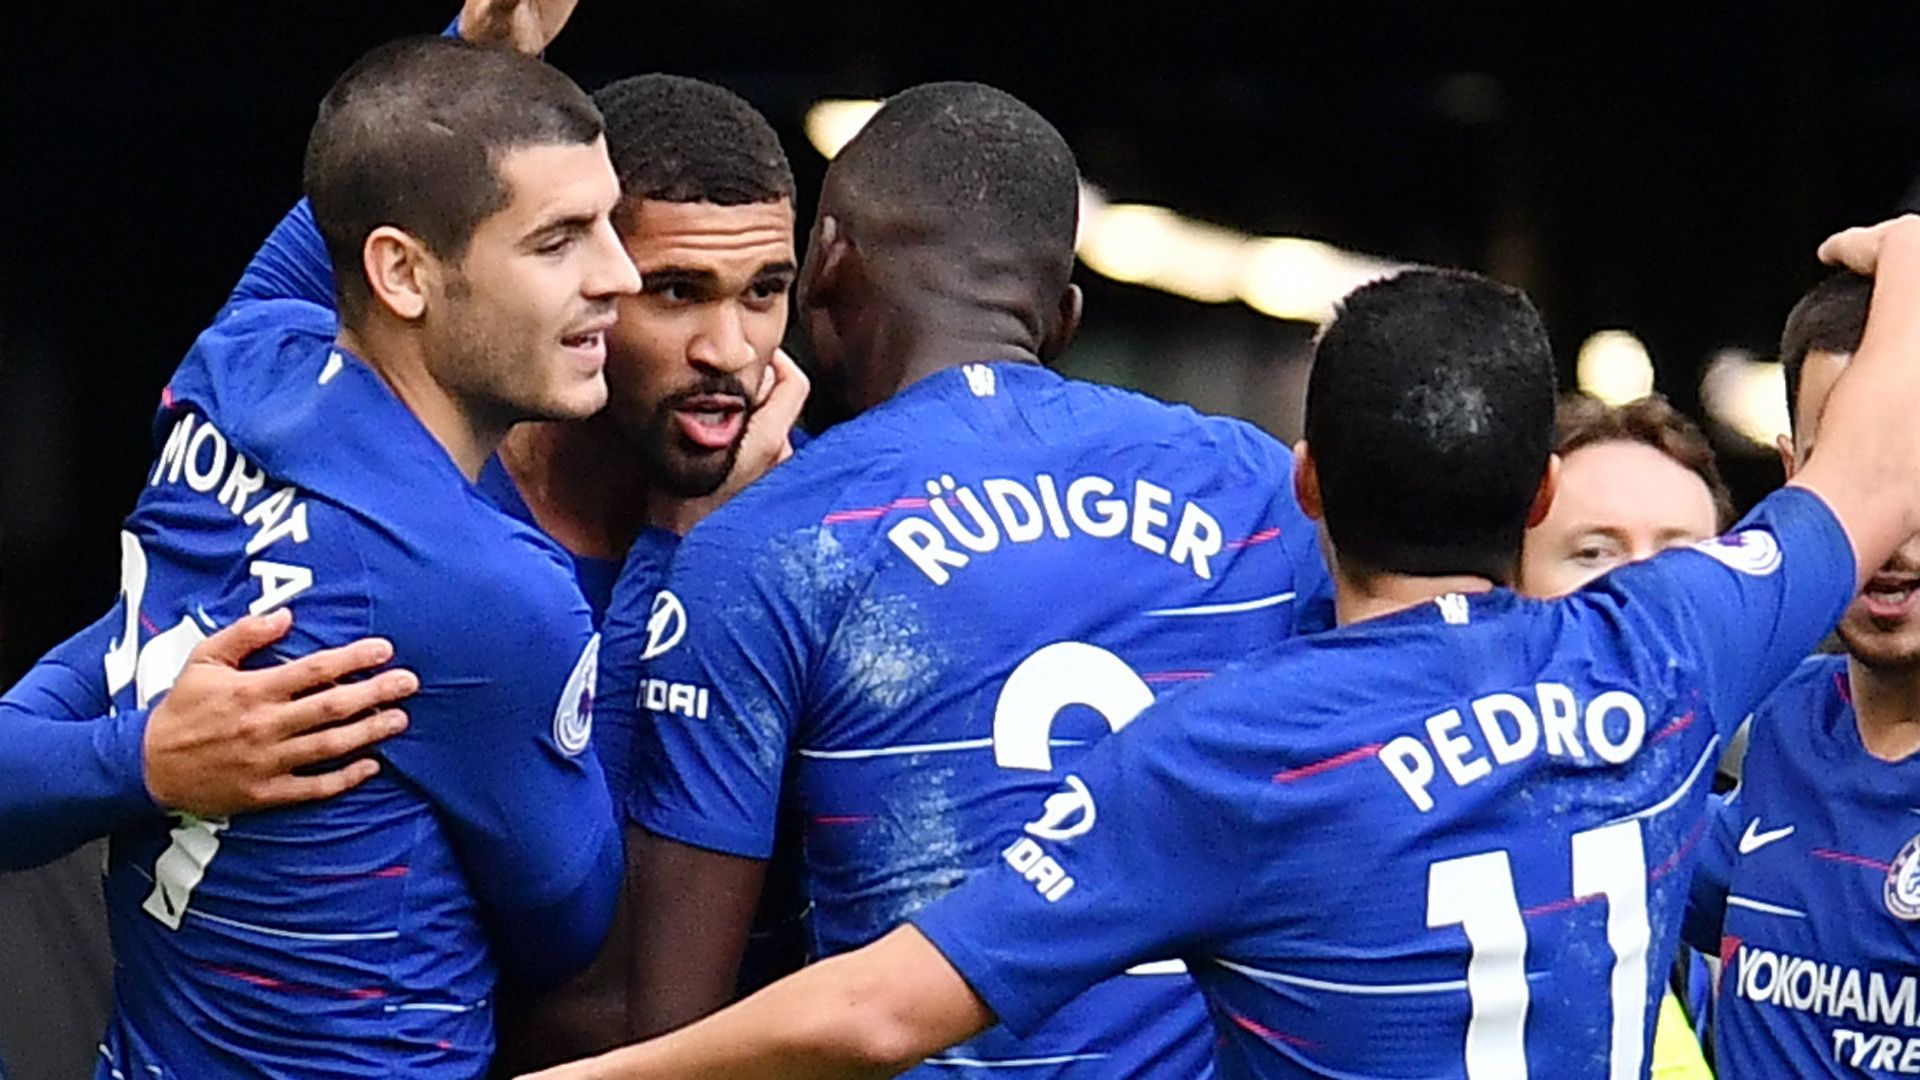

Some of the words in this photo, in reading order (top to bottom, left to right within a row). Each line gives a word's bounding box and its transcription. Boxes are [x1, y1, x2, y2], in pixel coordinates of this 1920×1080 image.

[151, 412, 313, 615] MORATA
[888, 474, 1223, 586] RÜDIGER
[1379, 682, 1646, 813] PEDRO
[1001, 836, 1075, 902] DAI
[1426, 819, 1652, 1080] 11
[1736, 945, 1920, 1027] YOKOHAM
